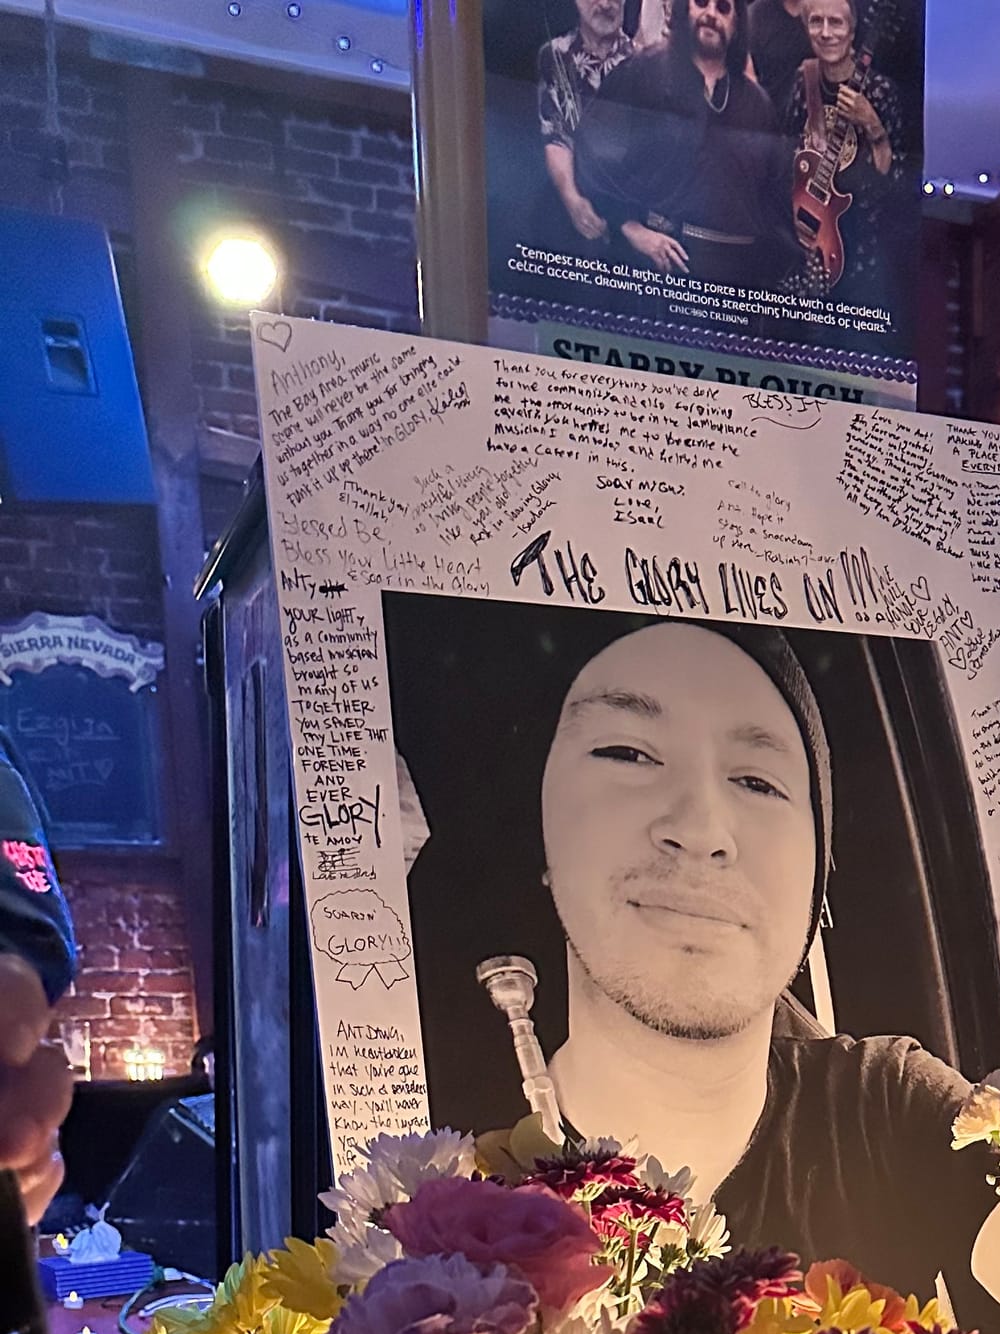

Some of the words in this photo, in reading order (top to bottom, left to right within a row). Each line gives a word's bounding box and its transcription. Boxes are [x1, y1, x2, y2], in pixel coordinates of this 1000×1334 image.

[508, 258, 546, 275] Celtic
[548, 266, 591, 284] accent,
[595, 274, 643, 296] drawing
[646, 285, 661, 296] on
[663, 289, 720, 308] traditions
[722, 299, 780, 319] stretching
[783, 306, 836, 325] hundreds
[838, 317, 850, 328] of
[614, 265, 632, 278] all
[666, 274, 687, 290] but
[690, 279, 702, 291] its
[704, 283, 736, 297] forte
[738, 288, 747, 298] is
[749, 290, 798, 307] folkrock
[800, 297, 825, 311] with
[826, 302, 835, 312] a
[836, 304, 890, 323] decidedly
[270, 349, 346, 397] Anthony,
[267, 404, 293, 427] The
[291, 389, 319, 413] Bay
[318, 375, 348, 398] Area
[348, 352, 381, 381] music
[271, 421, 304, 447] scene
[304, 407, 324, 427] will
[322, 390, 354, 414] never
[354, 382, 369, 395] be
[370, 365, 390, 383] the
[391, 345, 417, 370] same
[277, 436, 312, 464] without
[331, 406, 364, 431] Thank
[365, 395, 385, 417] you
[384, 383, 398, 400] for
[277, 471, 290, 487] us
[289, 443, 334, 478] together
[336, 440, 350, 453] in
[348, 434, 357, 446] a
[358, 418, 383, 439] way
[382, 410, 398, 422] no
[398, 394, 416, 413] one
[417, 379, 438, 398] else
[982, 430, 1000, 442] YOU
[952, 446, 961, 456] A
[970, 449, 998, 462] PLACE
[510, 528, 606, 604] THE
[625, 547, 710, 614] GLORY
[719, 562, 787, 621] LIVES
[804, 568, 845, 624] ON
[284, 635, 299, 648] as
[304, 631, 314, 645] a
[939, 619, 962, 653] ANT
[2, 636, 64, 659] SIERRA
[67, 634, 137, 665] NEVADA
[287, 647, 325, 664] based
[291, 664, 339, 688] brought
[297, 684, 337, 704] many
[324, 717, 366, 730] SAVED
[331, 730, 363, 743] LIFE
[297, 746, 326, 758] ONE
[302, 760, 367, 773] FOREVER
[314, 775, 345, 787] AND
[306, 787, 352, 802] EVER
[337, 1019, 364, 1041] ANT
[329, 1061, 358, 1077] that
[333, 1083, 346, 1095] in
[370, 1115, 391, 1129] the
